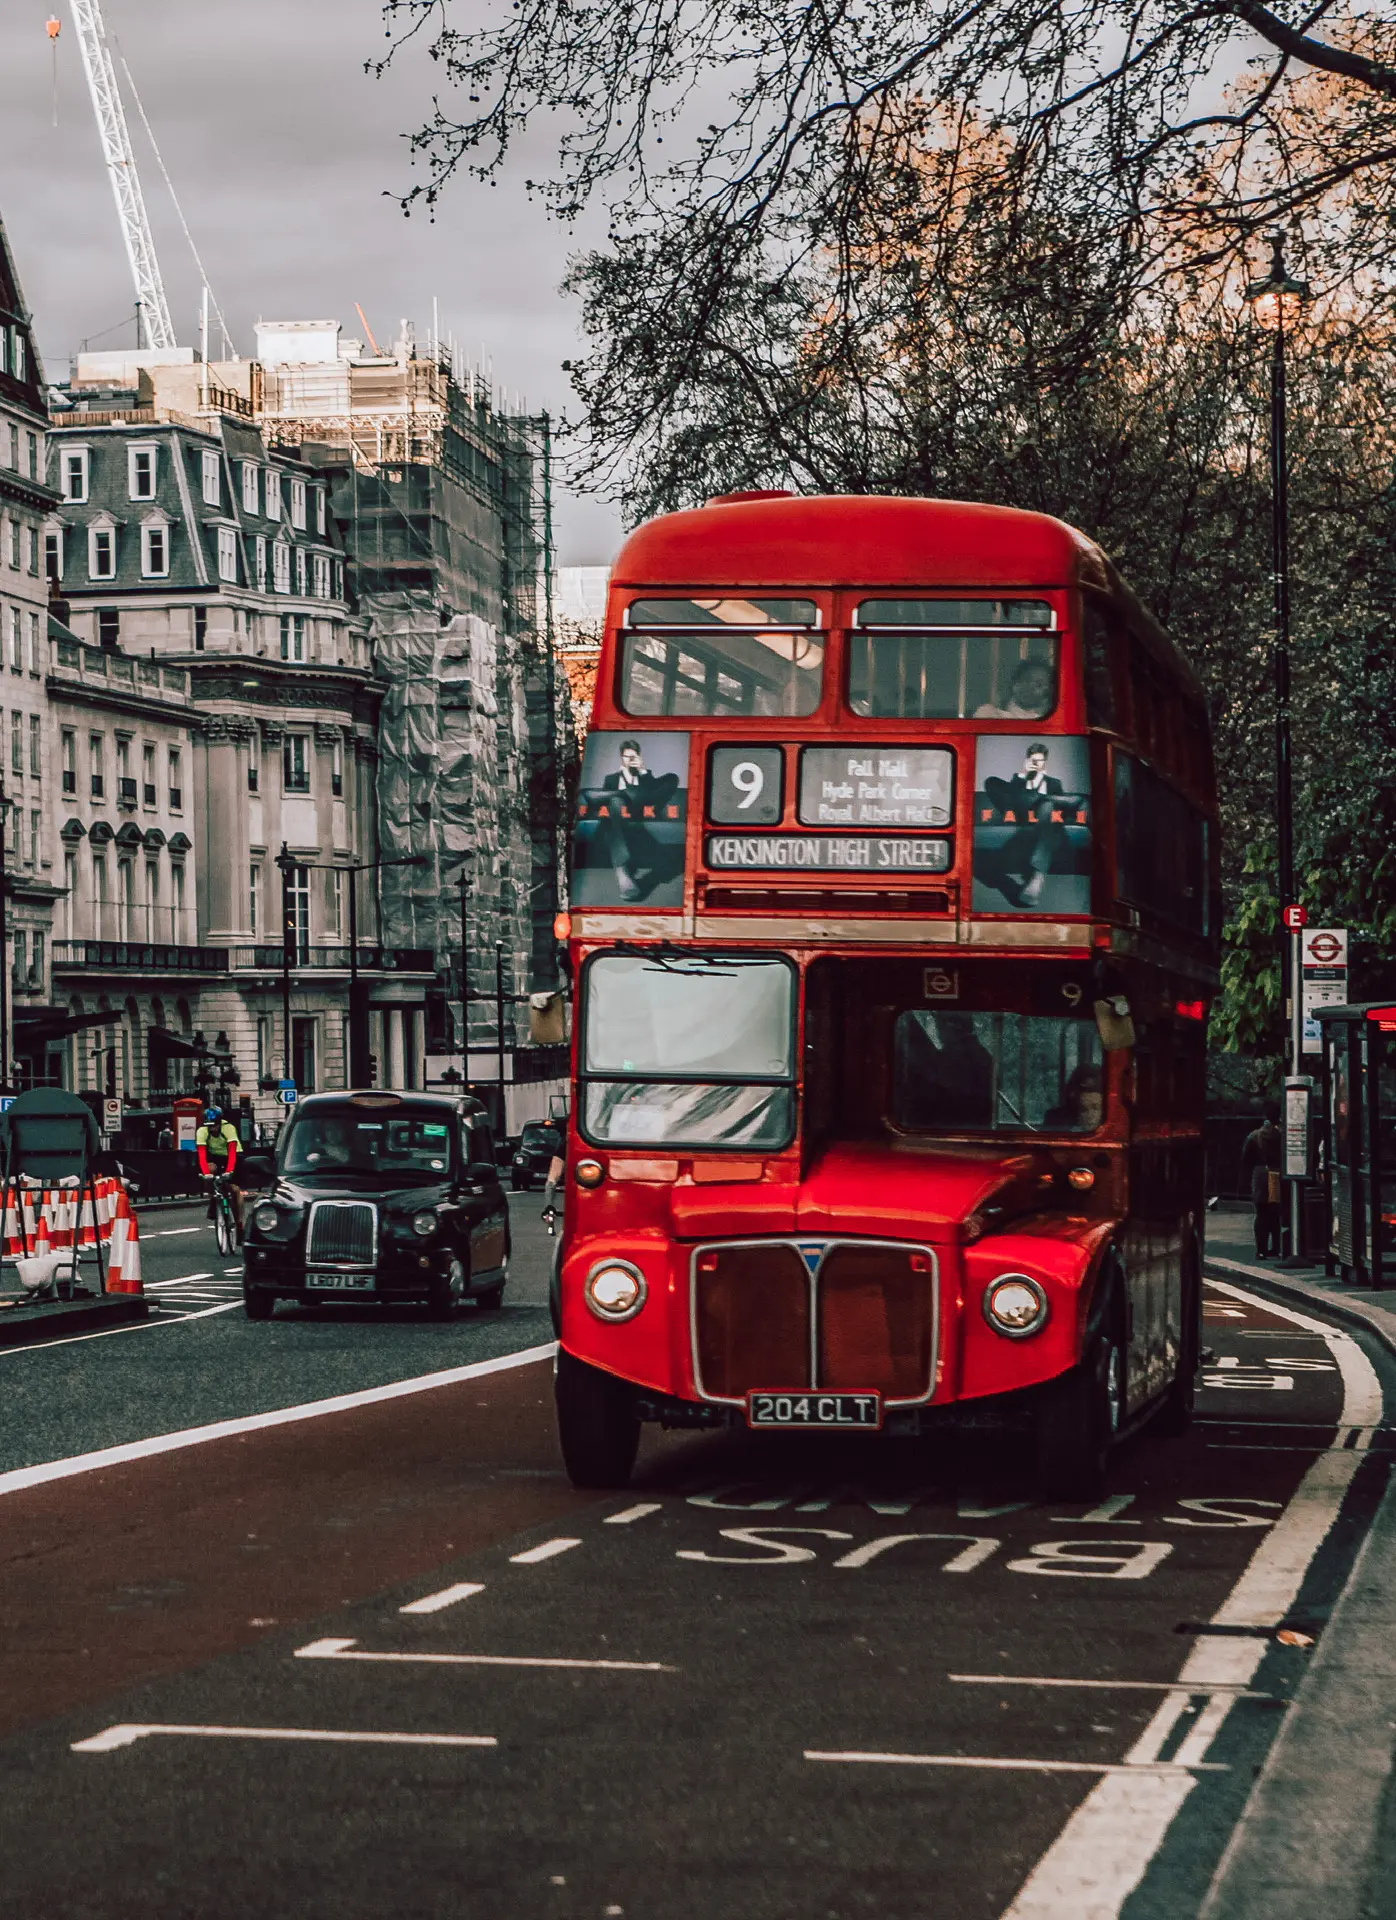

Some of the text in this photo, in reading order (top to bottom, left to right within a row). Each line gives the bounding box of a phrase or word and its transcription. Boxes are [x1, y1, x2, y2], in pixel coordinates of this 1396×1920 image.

[847, 759, 874, 777] Pall
[731, 762, 764, 809] 9
[822, 780, 933, 803] Hyde Park Corner
[818, 803, 853, 822] Royal
[858, 804, 901, 822] Albert
[981, 808, 1087, 823] FALKE
[711, 838, 945, 867] KENSINGTON HIGH STREET
[1289, 908, 1302, 927] E
[1062, 983, 1082, 1007] 9
[757, 1398, 871, 1421] 204 CLT
[676, 1526, 1173, 1580] BUS
